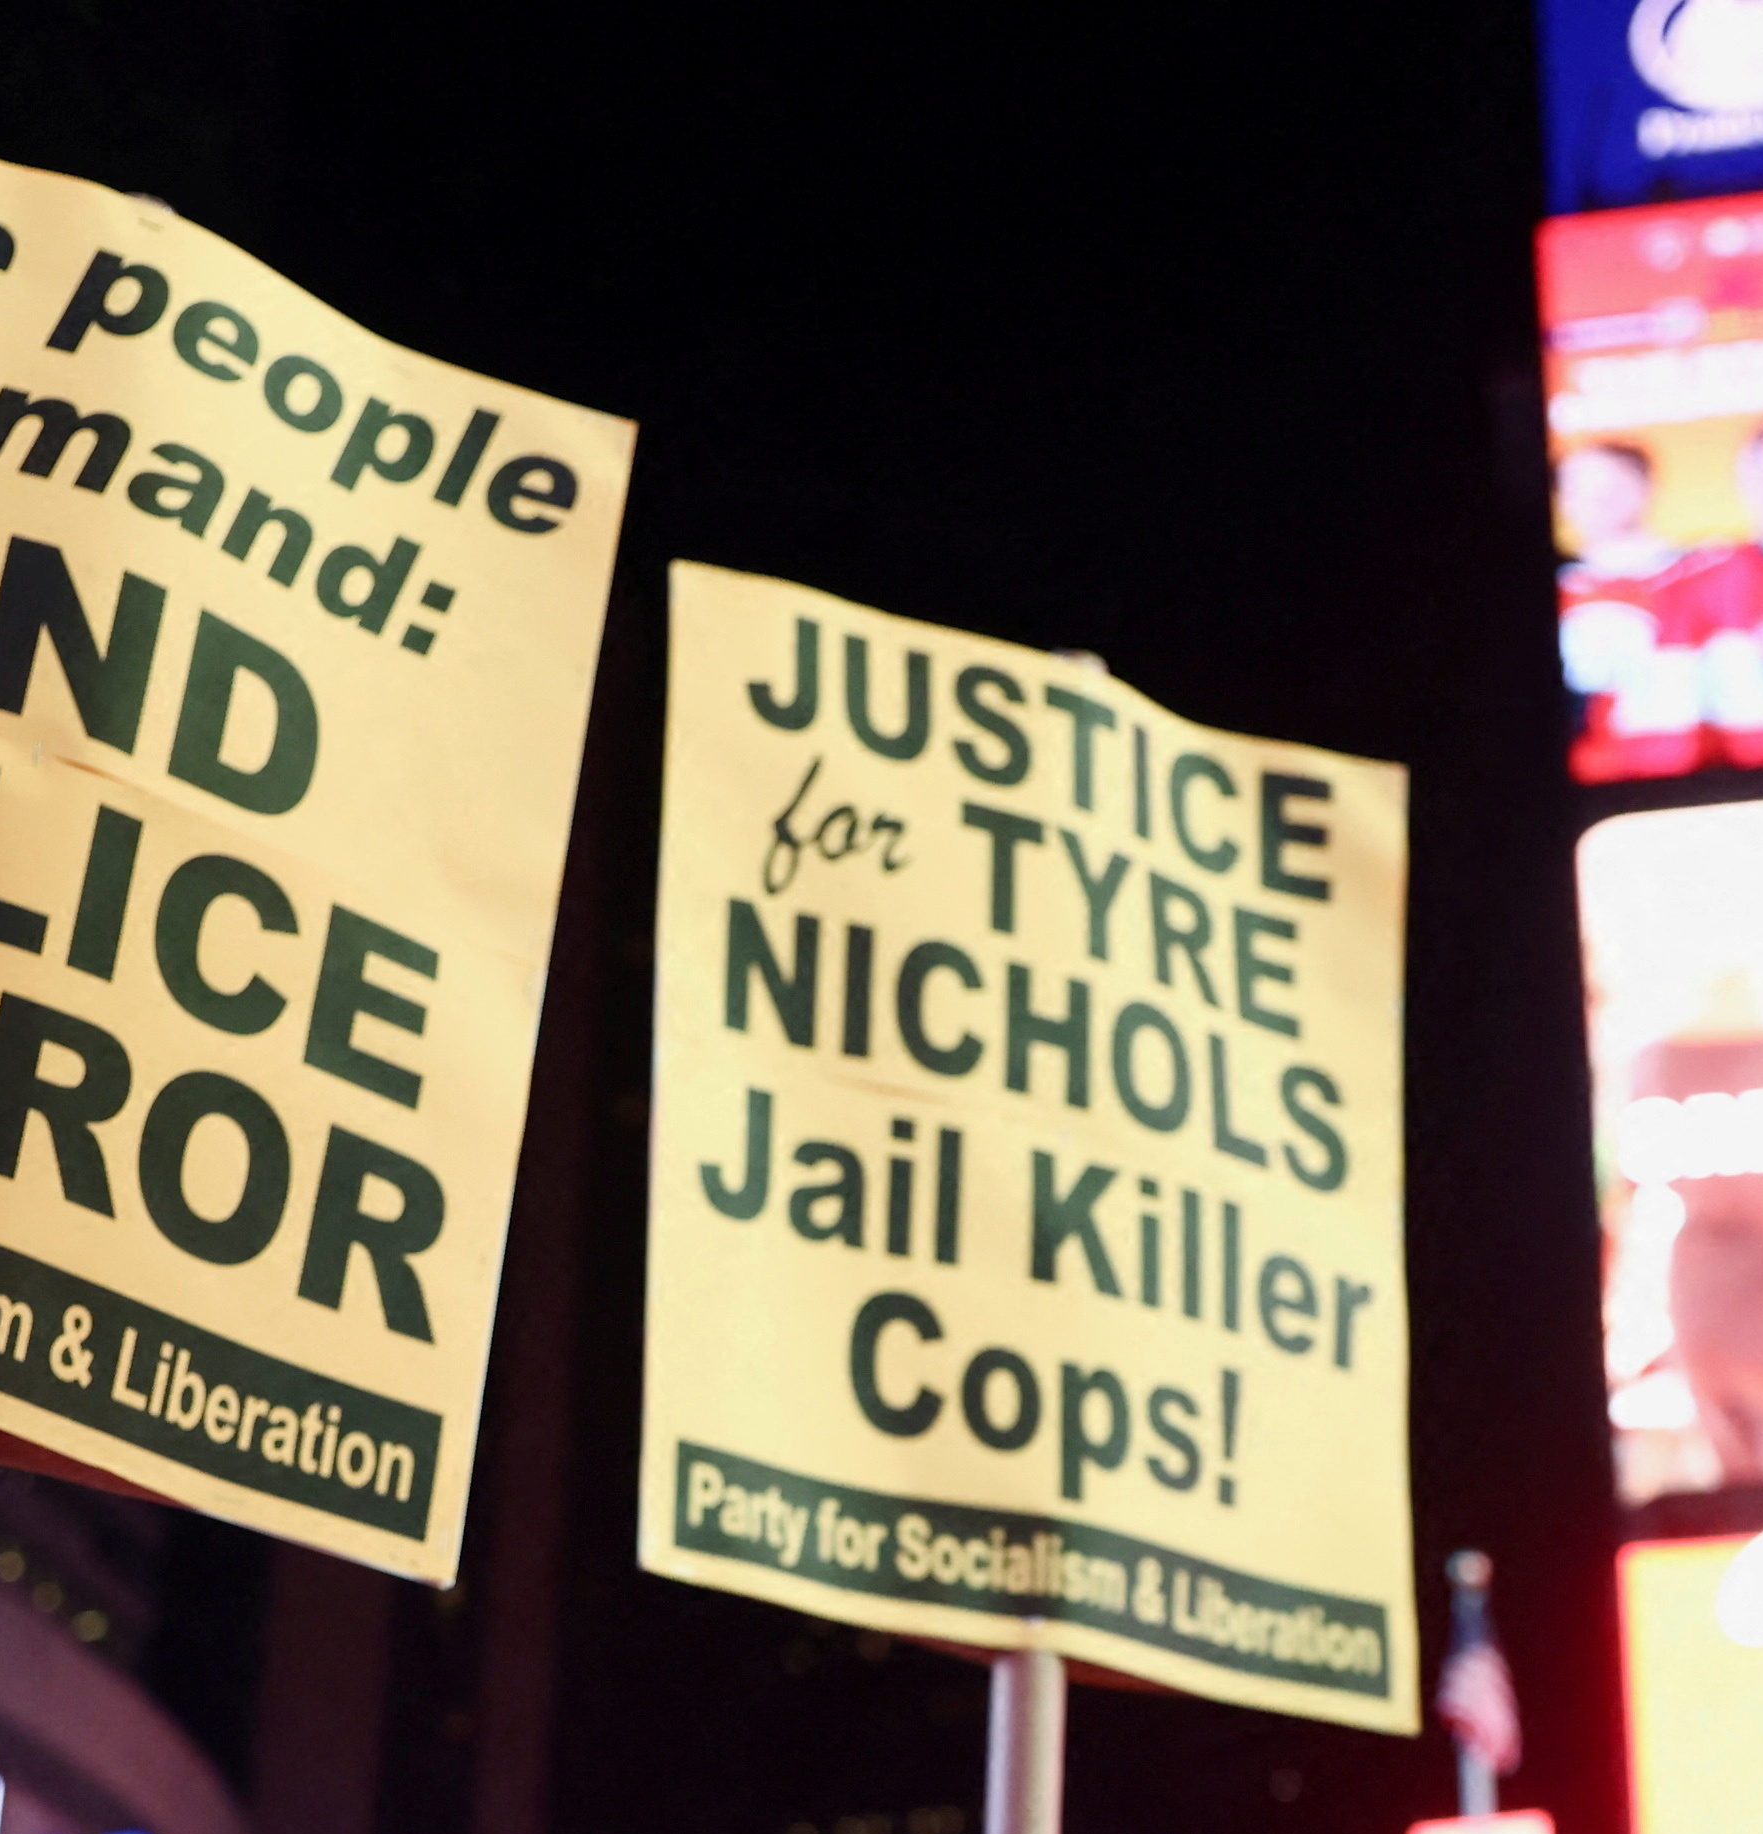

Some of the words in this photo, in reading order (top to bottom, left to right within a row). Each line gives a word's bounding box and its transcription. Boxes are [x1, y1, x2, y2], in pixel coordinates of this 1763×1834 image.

[46, 246, 582, 537] people
[746, 615, 1333, 902] JUSTICE
[762, 756, 912, 895] for
[962, 799, 1301, 1039] TYRE
[723, 898, 1349, 1195] NICHOLS
[698, 1087, 965, 1266] Jail
[1028, 1147, 1374, 1369] Killer
[49, 1304, 95, 1390] &
[111, 1326, 416, 1501] Liberation
[847, 1290, 1241, 1506] Cops!
[687, 1461, 809, 1568] Party
[815, 1498, 886, 1573] for
[894, 1513, 1128, 1616] Socialism
[1134, 1559, 1168, 1627] &
[1173, 1568, 1384, 1676] Liberation
